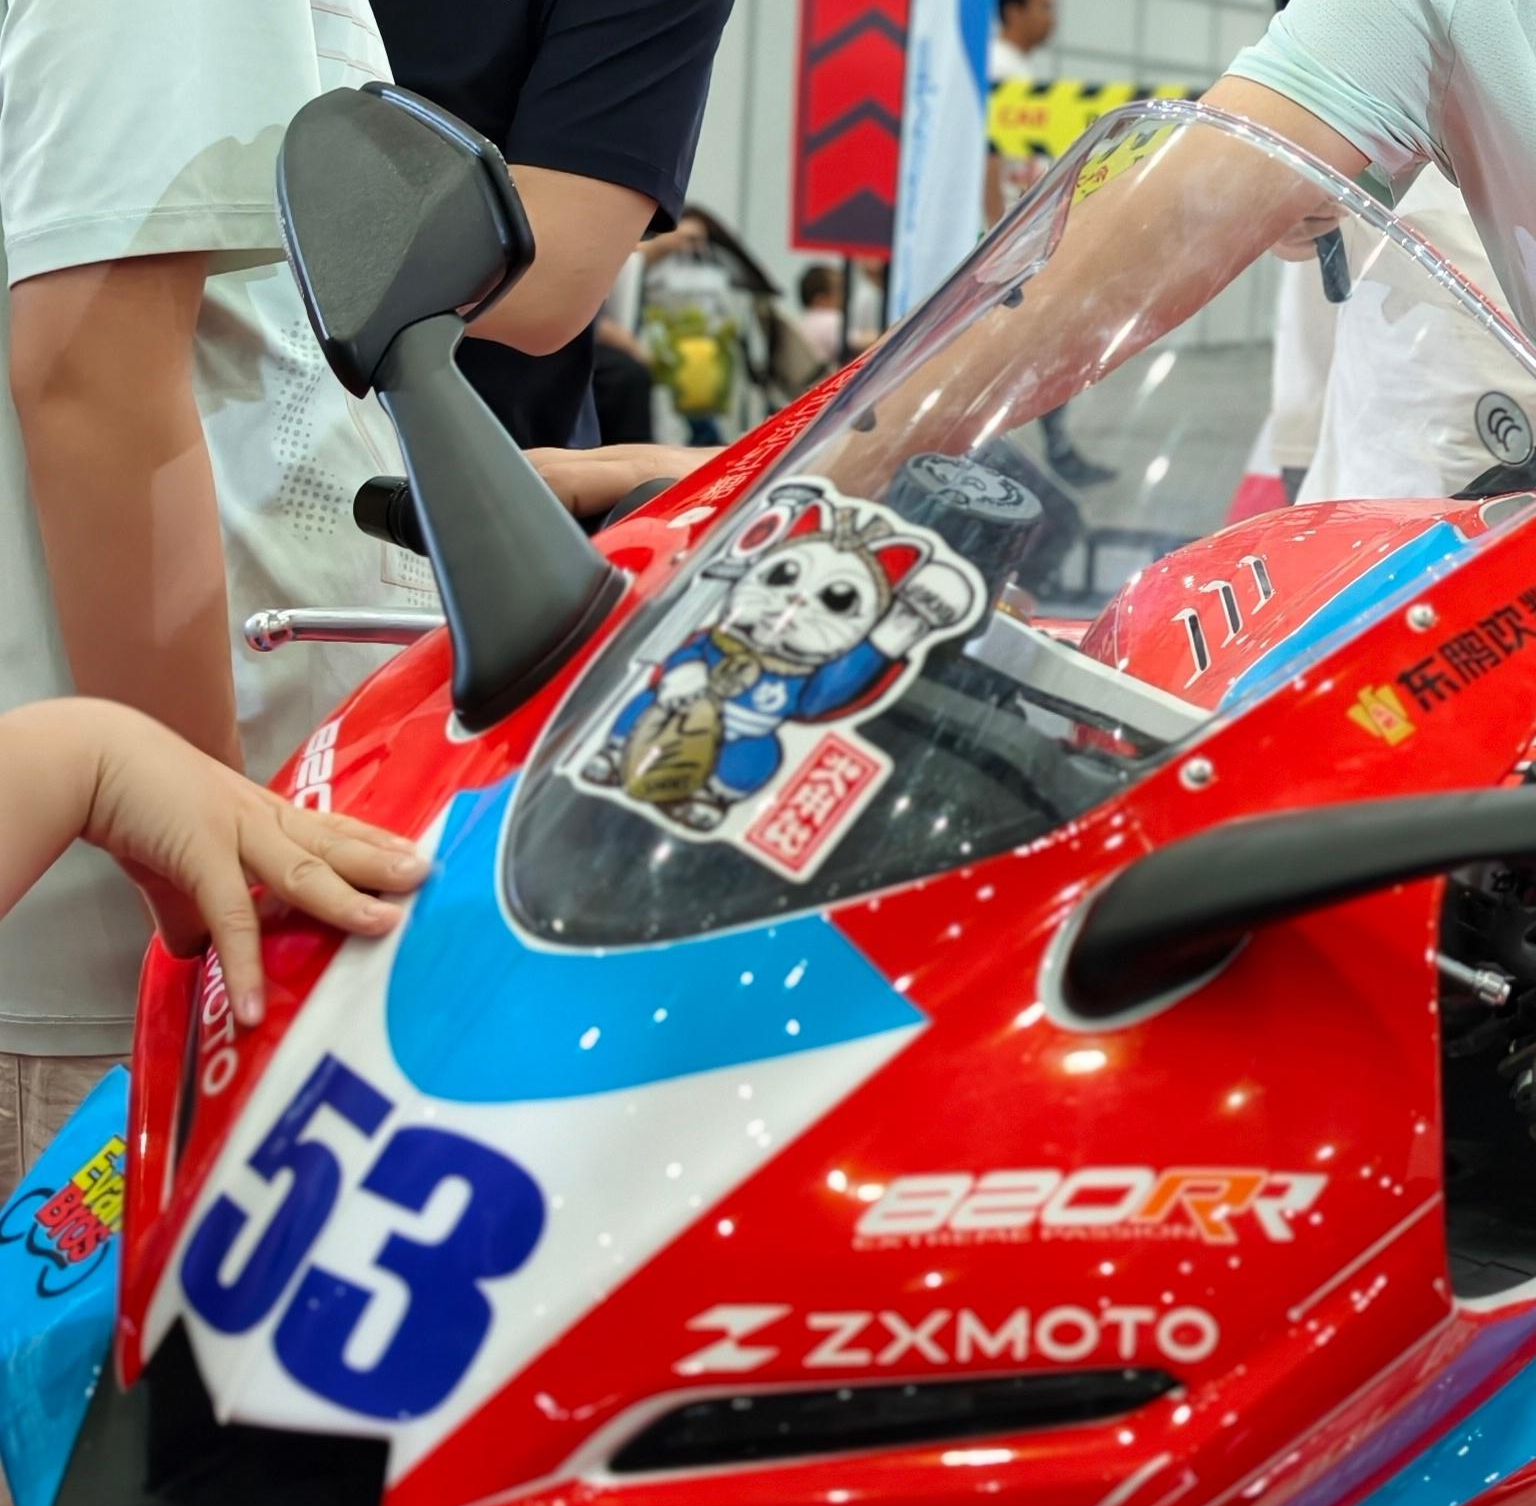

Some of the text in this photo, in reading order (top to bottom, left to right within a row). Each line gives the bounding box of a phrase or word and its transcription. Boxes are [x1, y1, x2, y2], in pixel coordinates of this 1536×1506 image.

[34, 1182, 113, 1264] Bros
[178, 1051, 548, 1424] 53
[855, 1166, 1330, 1245] 820RR
[803, 1305, 1220, 1368] ZXMOTO
